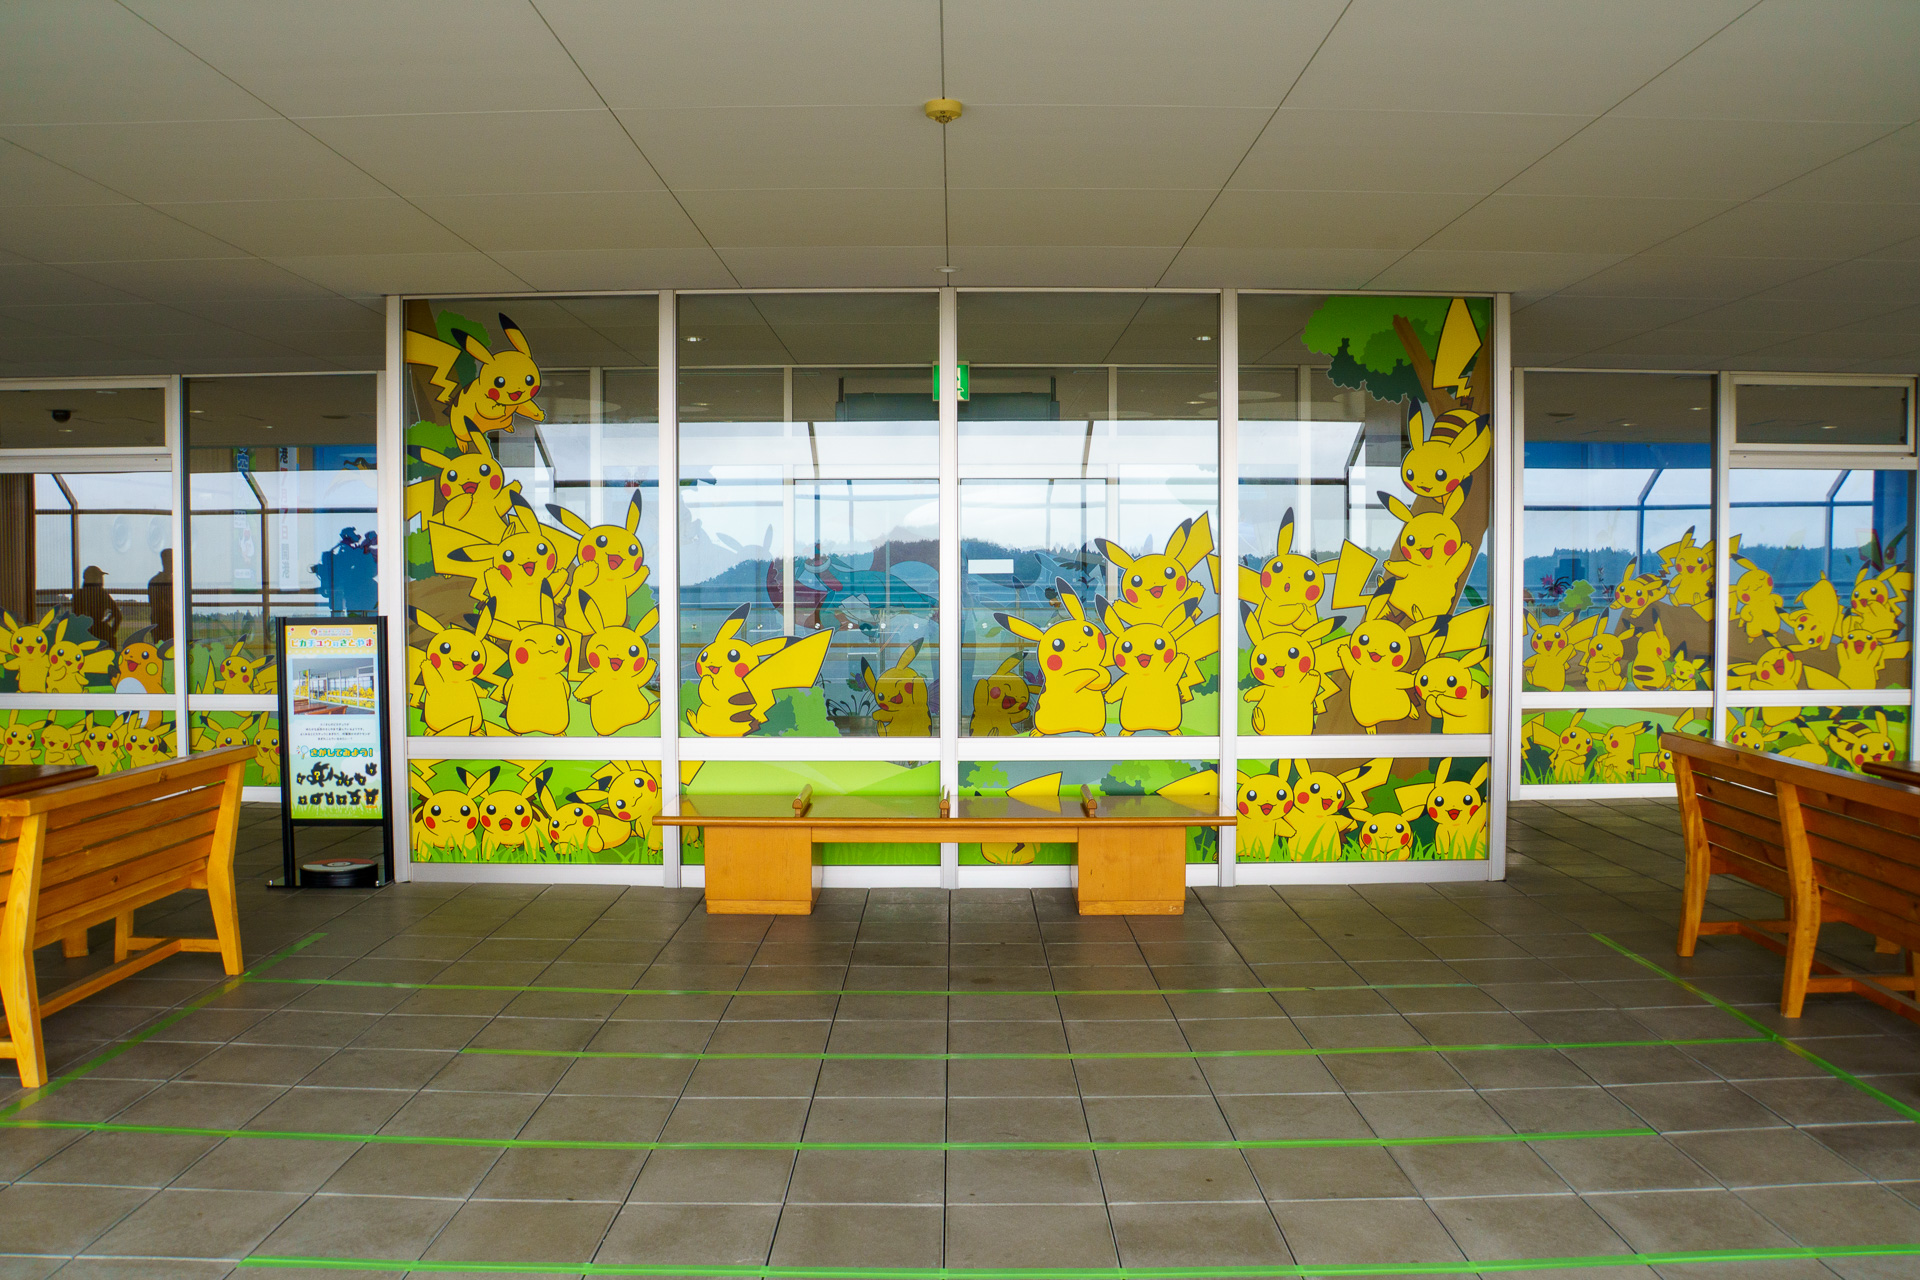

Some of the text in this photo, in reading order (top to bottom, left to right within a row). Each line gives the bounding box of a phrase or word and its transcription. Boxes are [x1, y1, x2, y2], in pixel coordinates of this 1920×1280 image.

[290, 639, 374, 648] ピカチュウのさとやま
